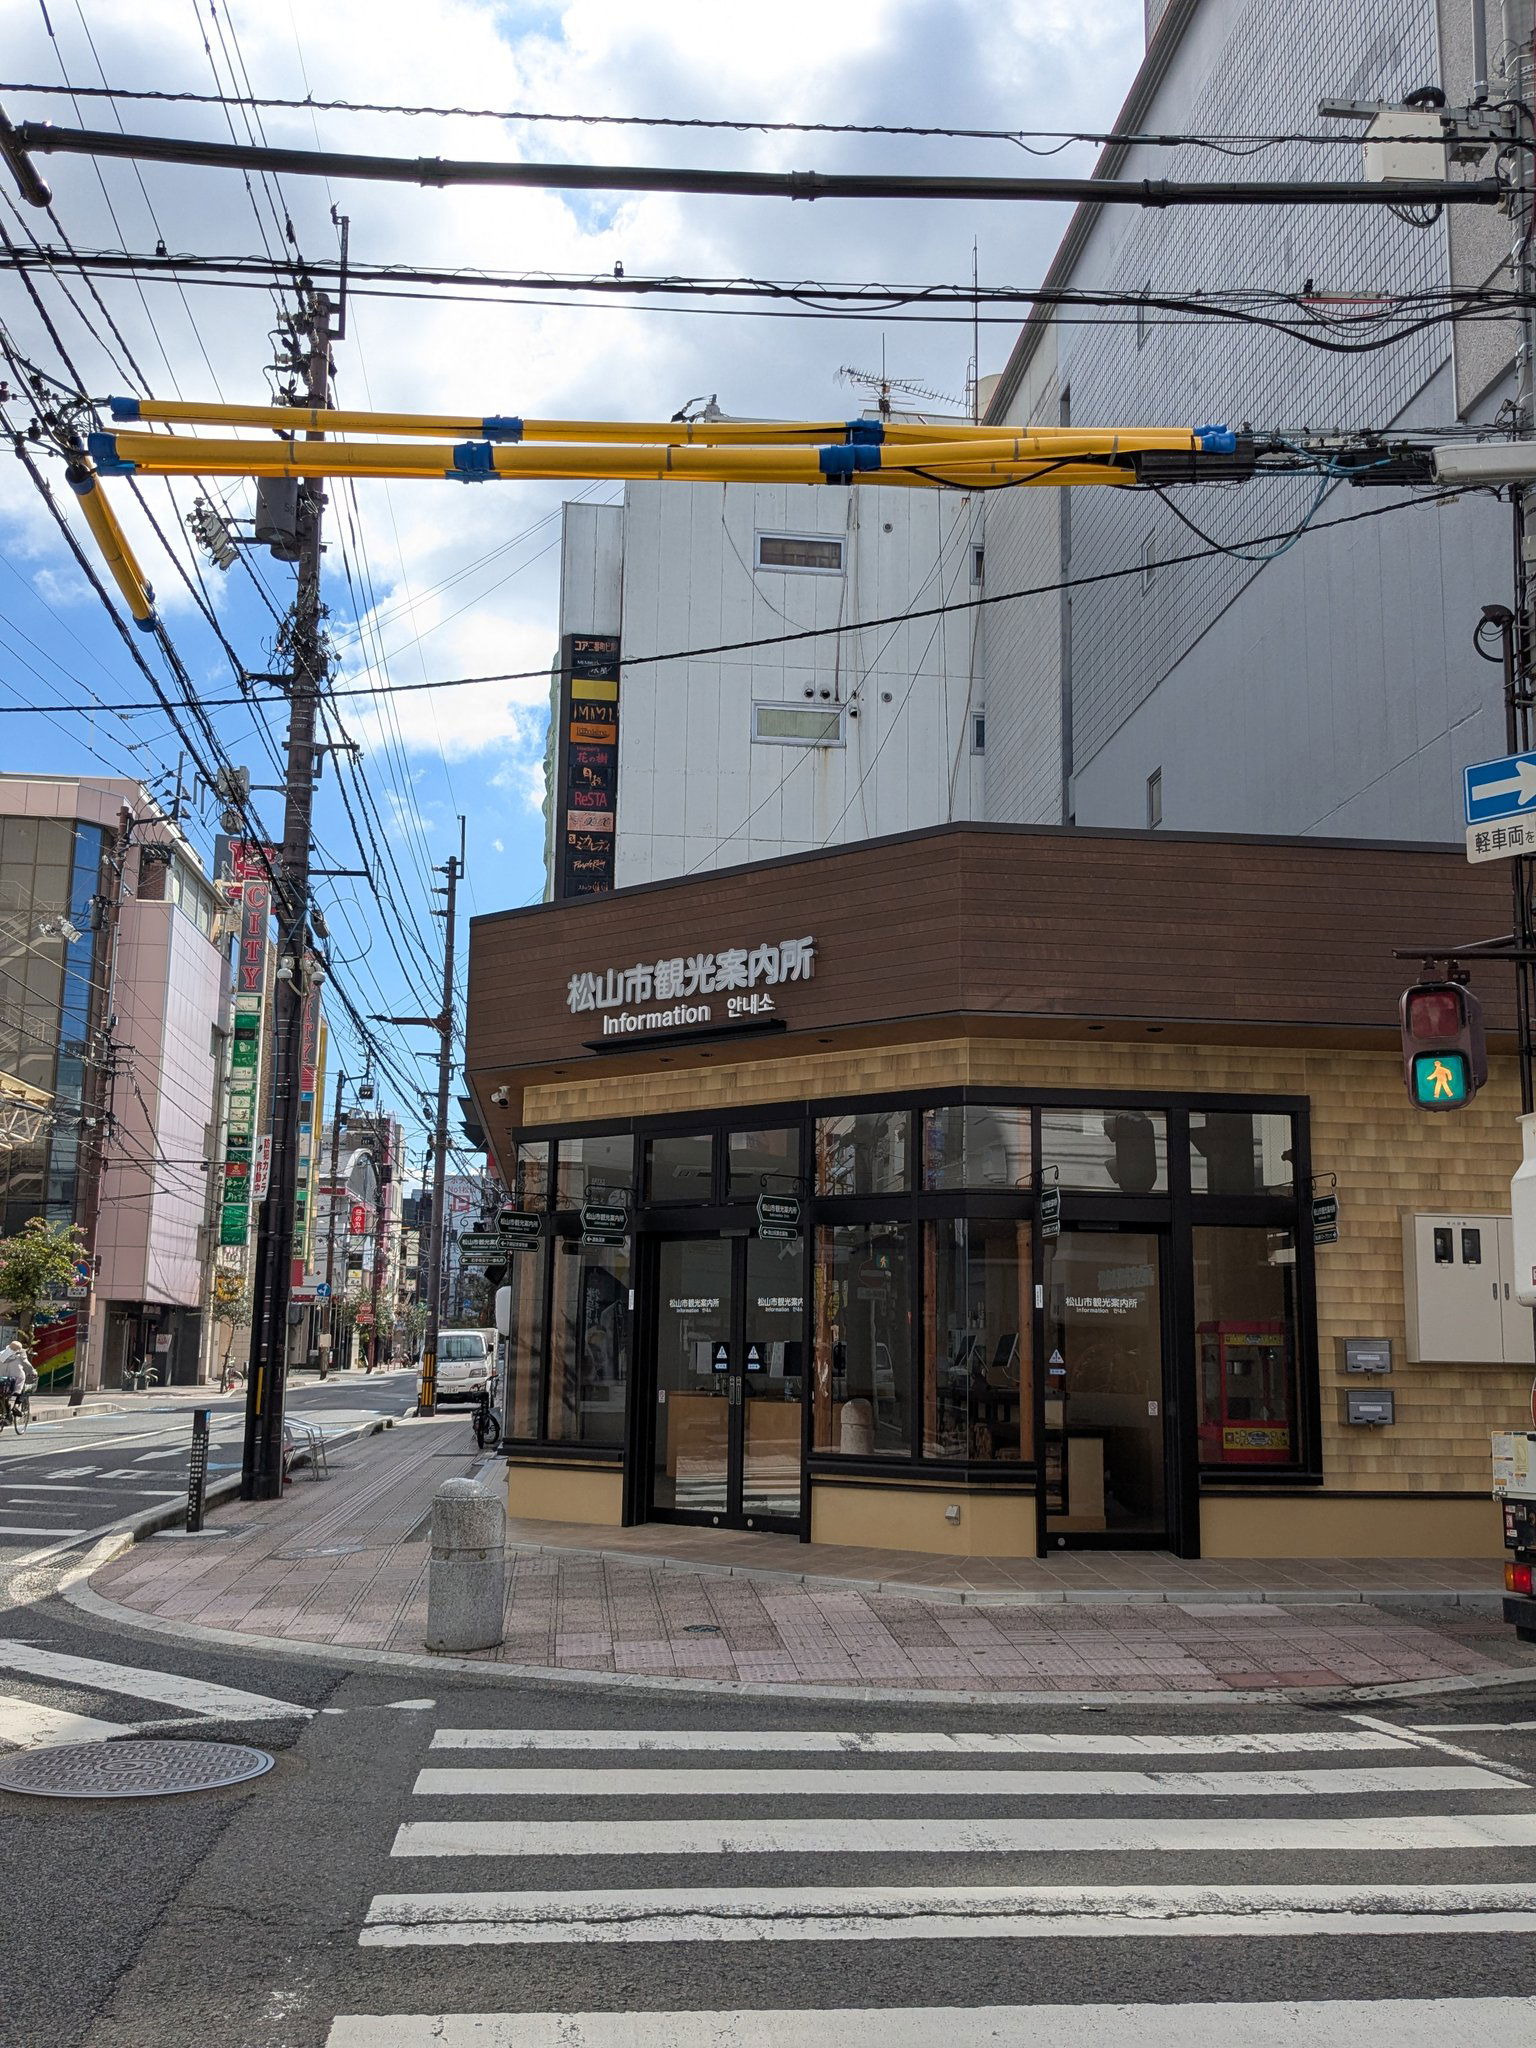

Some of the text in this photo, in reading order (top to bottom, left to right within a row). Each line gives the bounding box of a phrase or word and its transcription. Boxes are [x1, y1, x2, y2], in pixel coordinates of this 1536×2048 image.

[574, 791, 608, 806] ReSTA
[1474, 824, 1535, 854] 軽車両を
[241, 884, 267, 990] CITY
[567, 935, 816, 1015] 松山市観光案内所
[603, 992, 776, 1036] Information 안내소
[669, 1298, 720, 1308] 松山市観光案内所
[1065, 1296, 1138, 1308] 松山市観光案内所
[1076, 1306, 1109, 1314] Information
